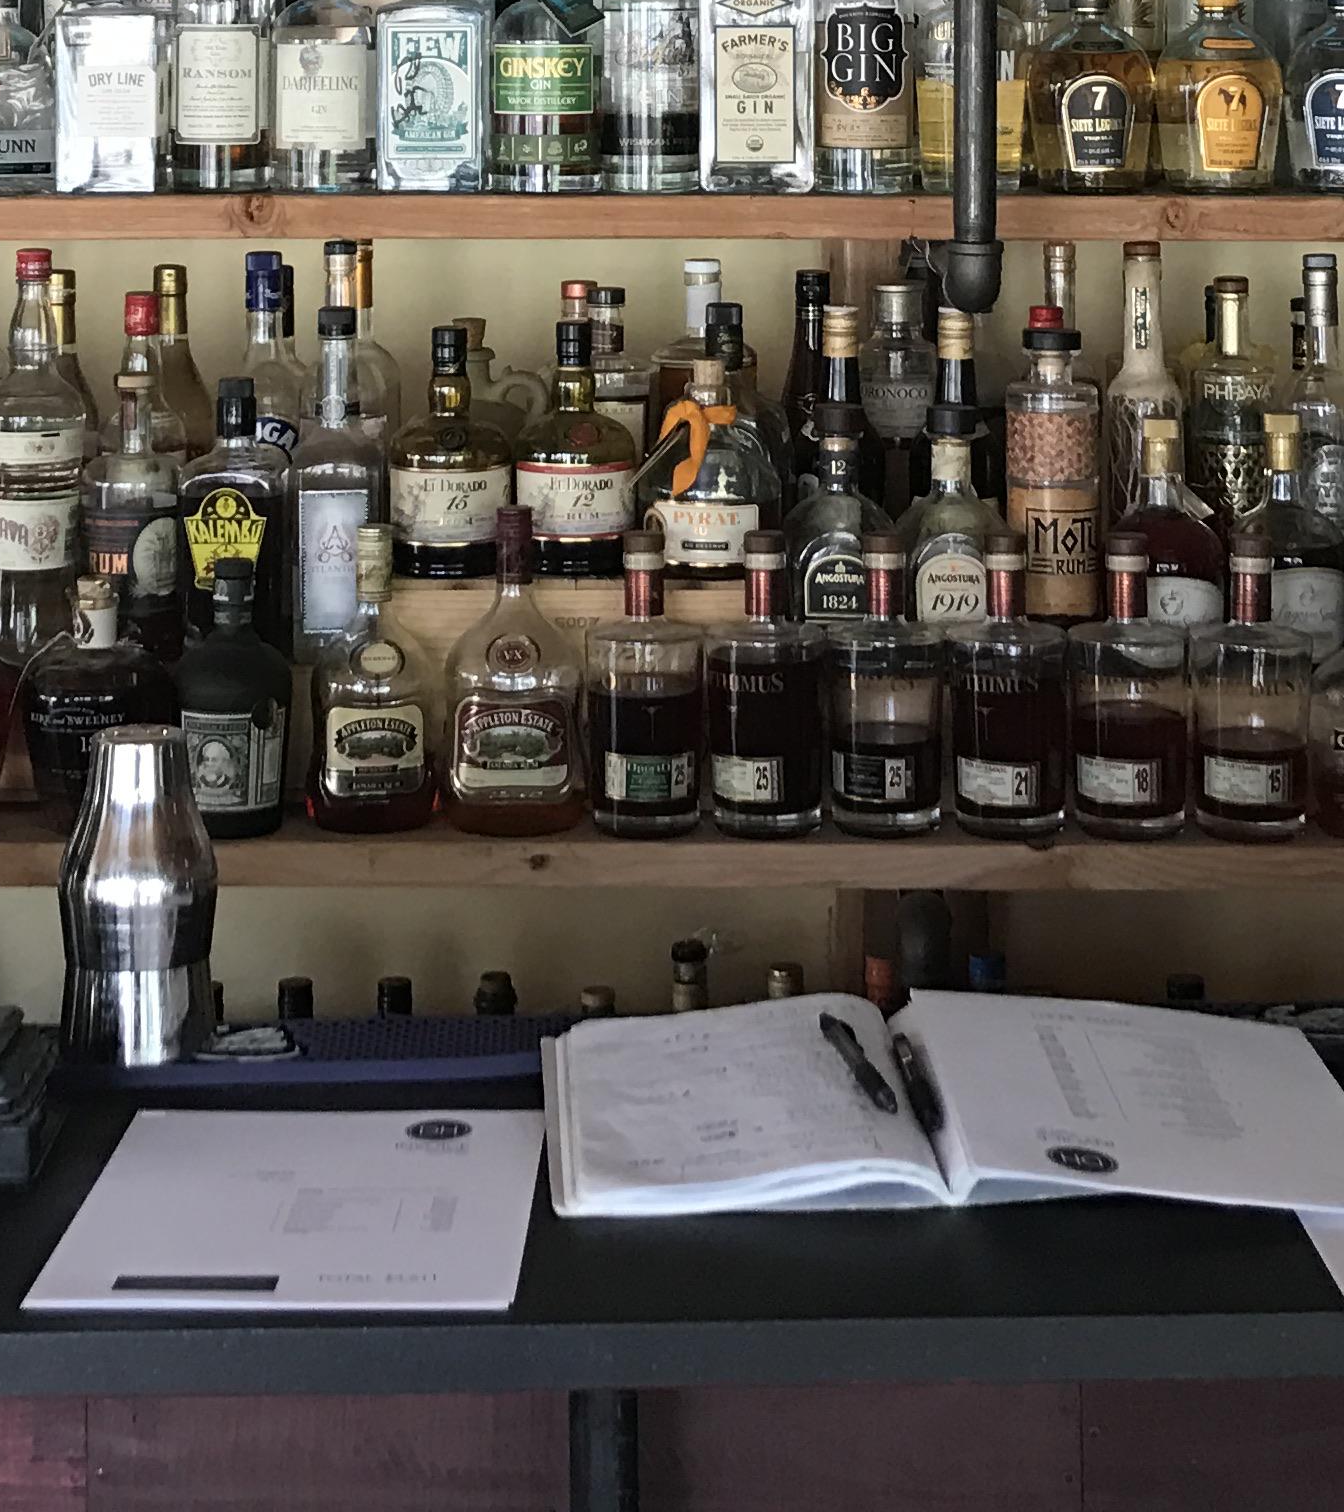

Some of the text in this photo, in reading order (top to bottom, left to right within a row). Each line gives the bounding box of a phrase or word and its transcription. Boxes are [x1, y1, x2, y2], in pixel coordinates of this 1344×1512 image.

[721, 33, 790, 54] FARMER'S
[836, 23, 894, 53] BIG
[398, 32, 465, 63] FEW
[182, 67, 253, 79] RANSOM
[500, 56, 585, 79] GINSKEY
[831, 54, 896, 83] GIN
[88, 71, 146, 88] DRY LINE
[282, 75, 359, 92] DARJEELING
[530, 79, 552, 90] GIN
[534, 95, 577, 107] DISTILLERY
[736, 99, 774, 114] GIN
[1090, 86, 1109, 110] 7
[1071, 118, 1093, 131] SIETE
[1313, 116, 1336, 131] SIETE
[829, 459, 847, 475] 12
[439, 478, 488, 492] DORADO
[567, 478, 613, 491] DORADO
[673, 510, 740, 526] PYRAT
[89, 551, 129, 574] RUM
[1056, 559, 1087, 576] RUM
[814, 571, 864, 585] ANGOSTURA
[926, 572, 981, 585] ANGOSTURA
[821, 593, 859, 610] 1824
[930, 593, 980, 613] 1919
[67, 711, 126, 724] SWEENEY
[471, 711, 554, 734] APPLETON ESTATE
[340, 717, 414, 737] APPLETON ESTATE
[674, 764, 687, 785] 25
[755, 764, 769, 790] 25
[887, 763, 903, 785] 25
[1134, 768, 1149, 792] 18
[1268, 769, 1282, 792] 15
[1014, 772, 1029, 796] 21
